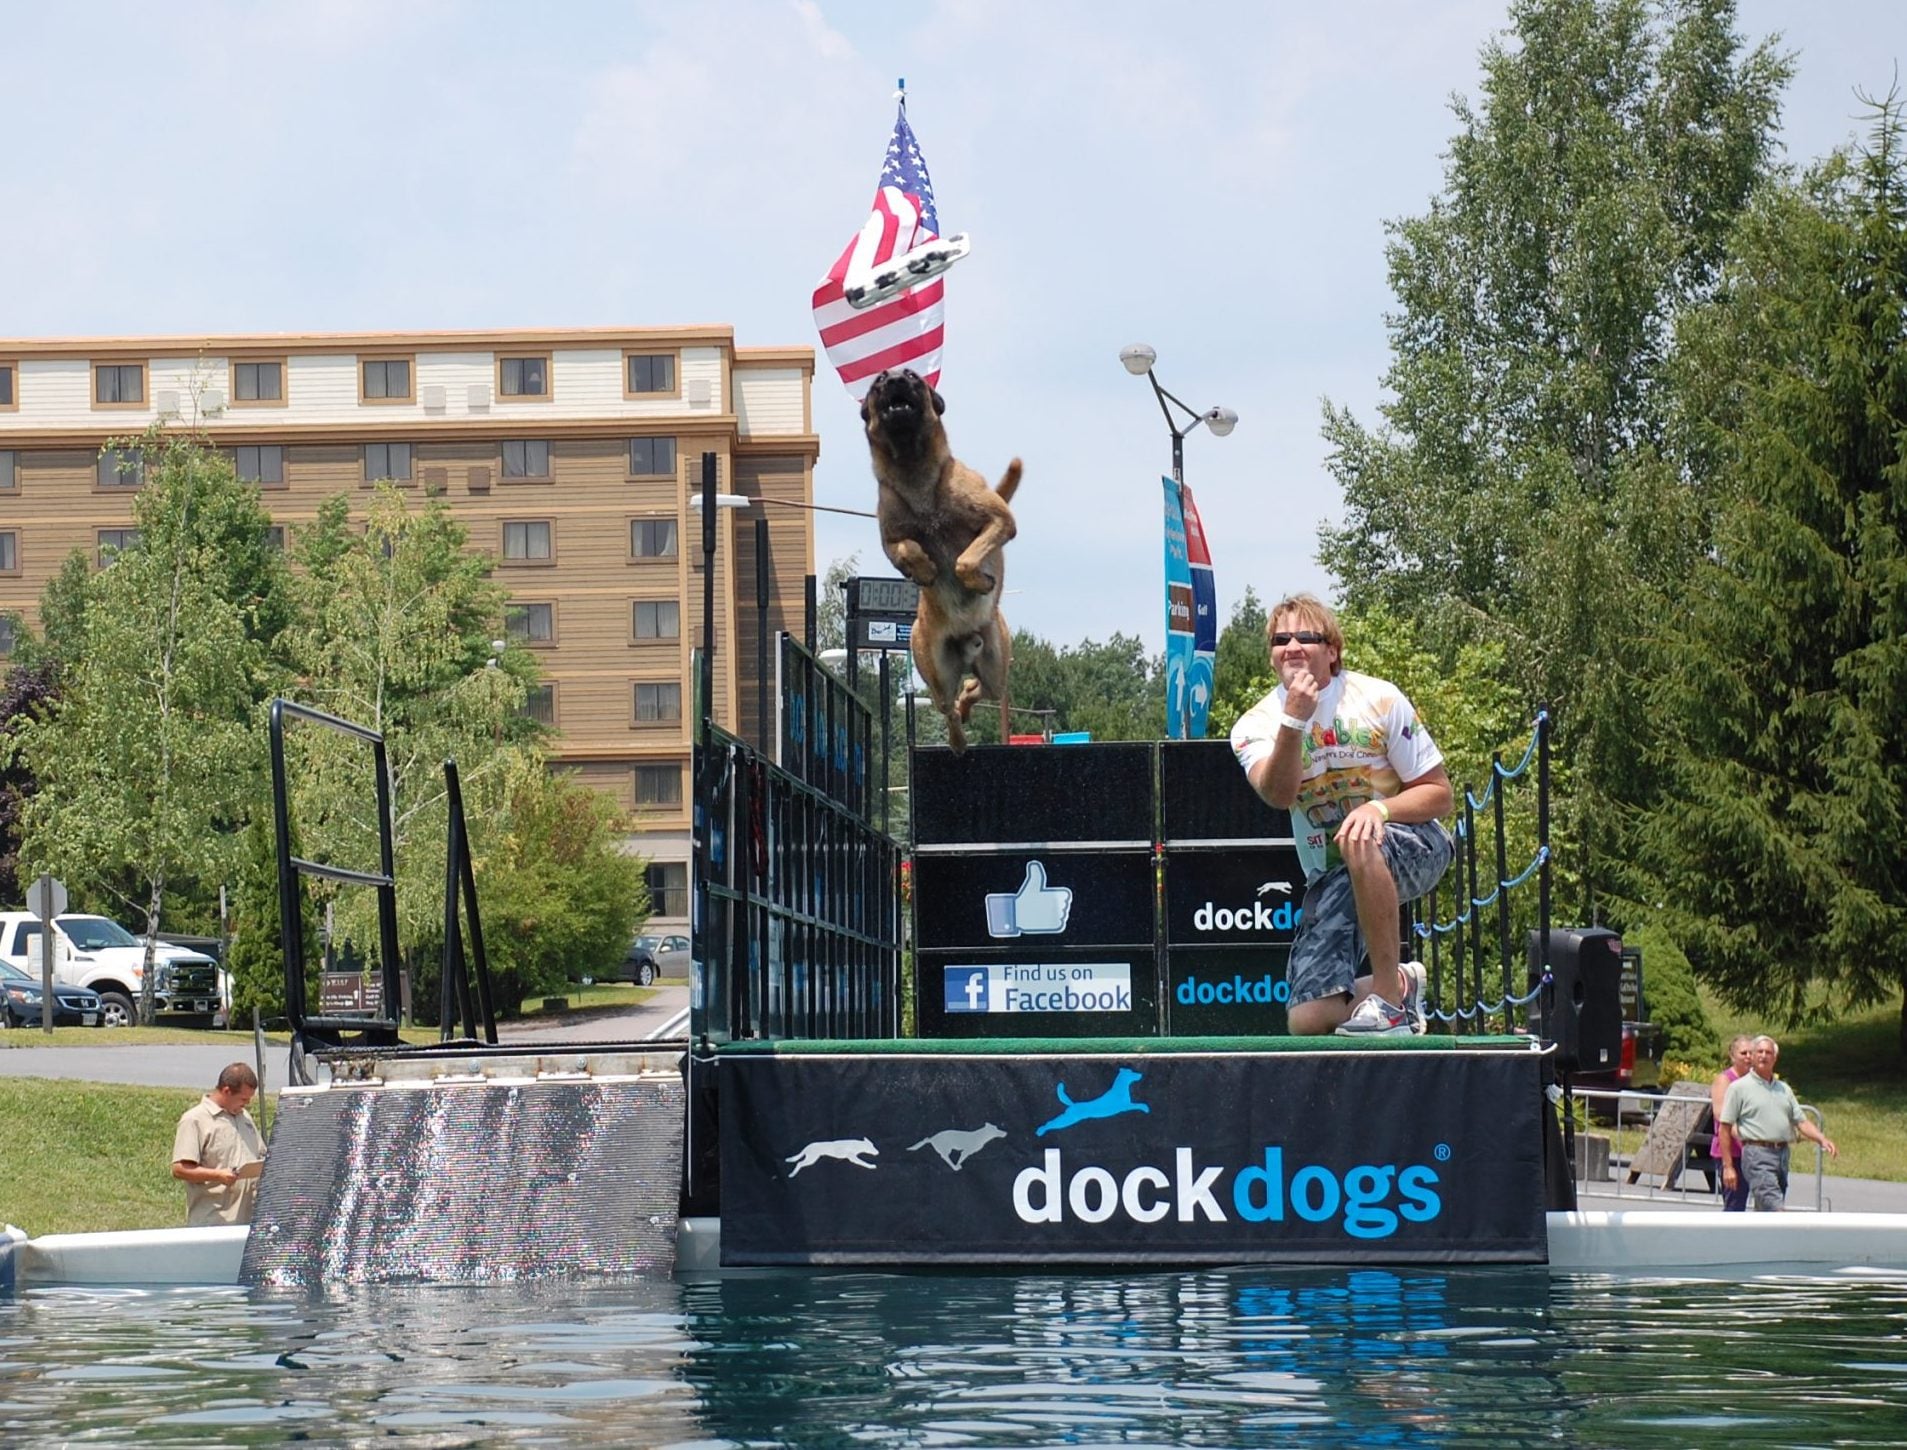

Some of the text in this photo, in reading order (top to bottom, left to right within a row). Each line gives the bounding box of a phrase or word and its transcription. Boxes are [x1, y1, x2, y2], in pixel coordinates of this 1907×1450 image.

[1004, 963, 1093, 981] Find us on
[1005, 985, 1130, 1011] Facebook
